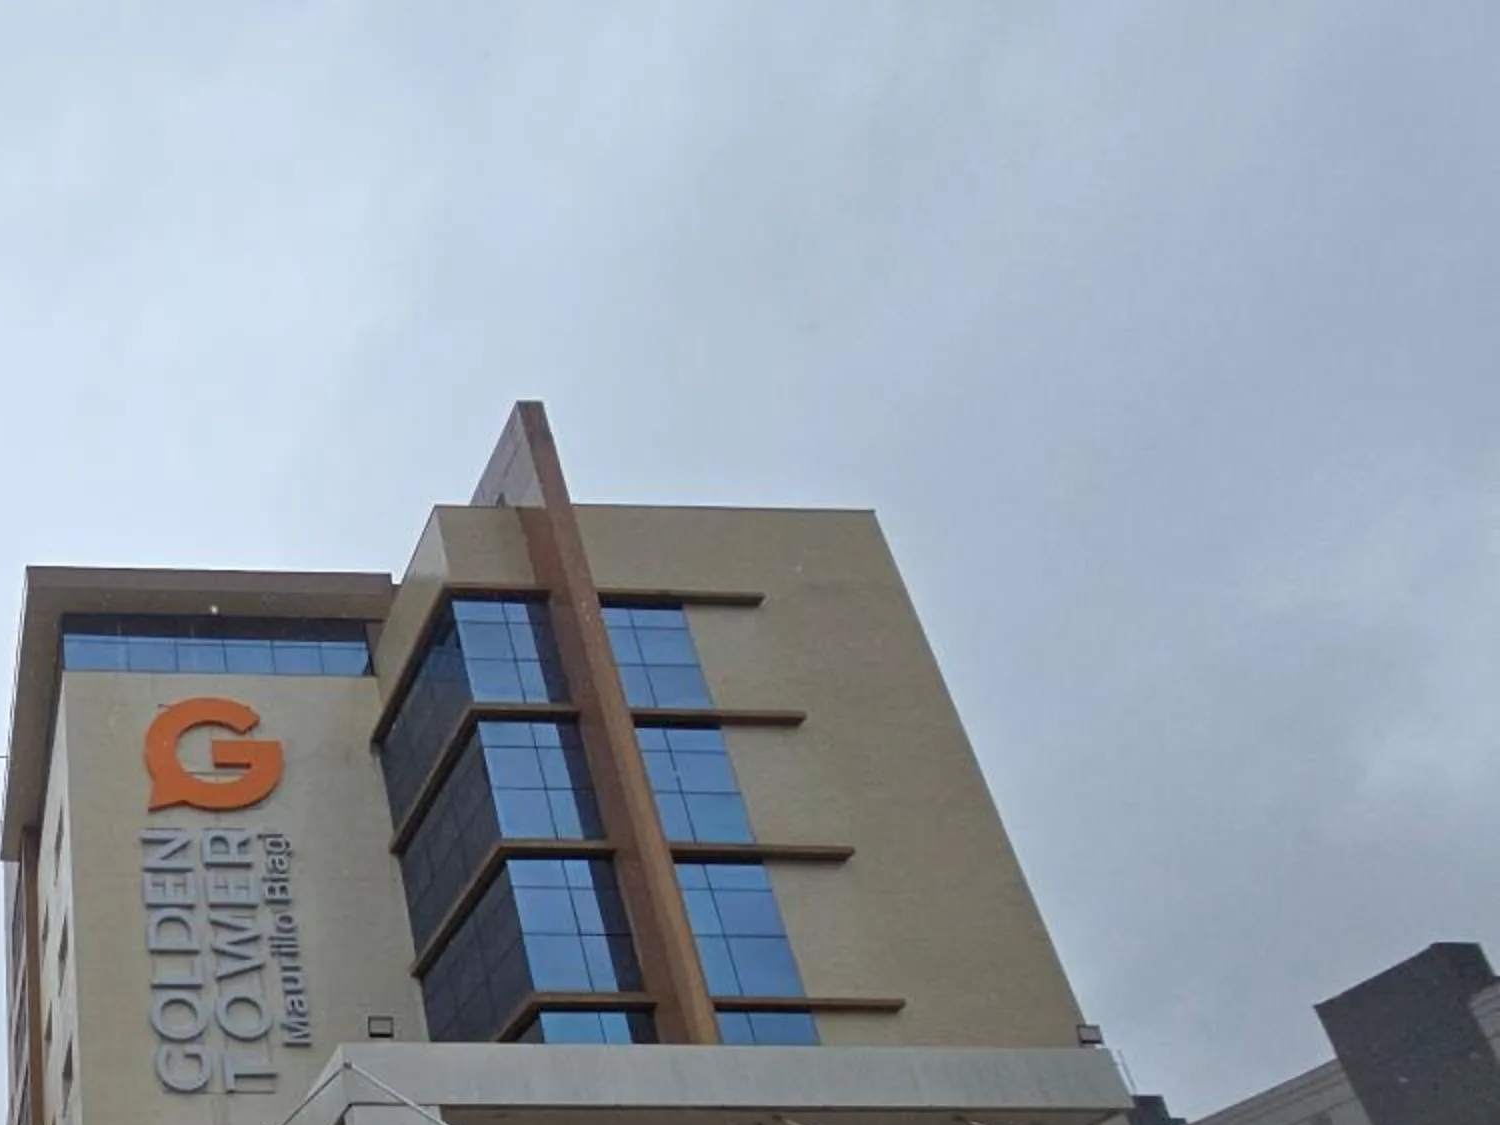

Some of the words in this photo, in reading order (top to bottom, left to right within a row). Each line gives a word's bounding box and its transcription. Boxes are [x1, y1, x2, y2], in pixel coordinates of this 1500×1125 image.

[144, 697, 286, 813] G
[139, 827, 213, 1093] GOLDEN
[202, 827, 278, 1095] TOWER
[268, 909, 312, 1049] Maurilio
